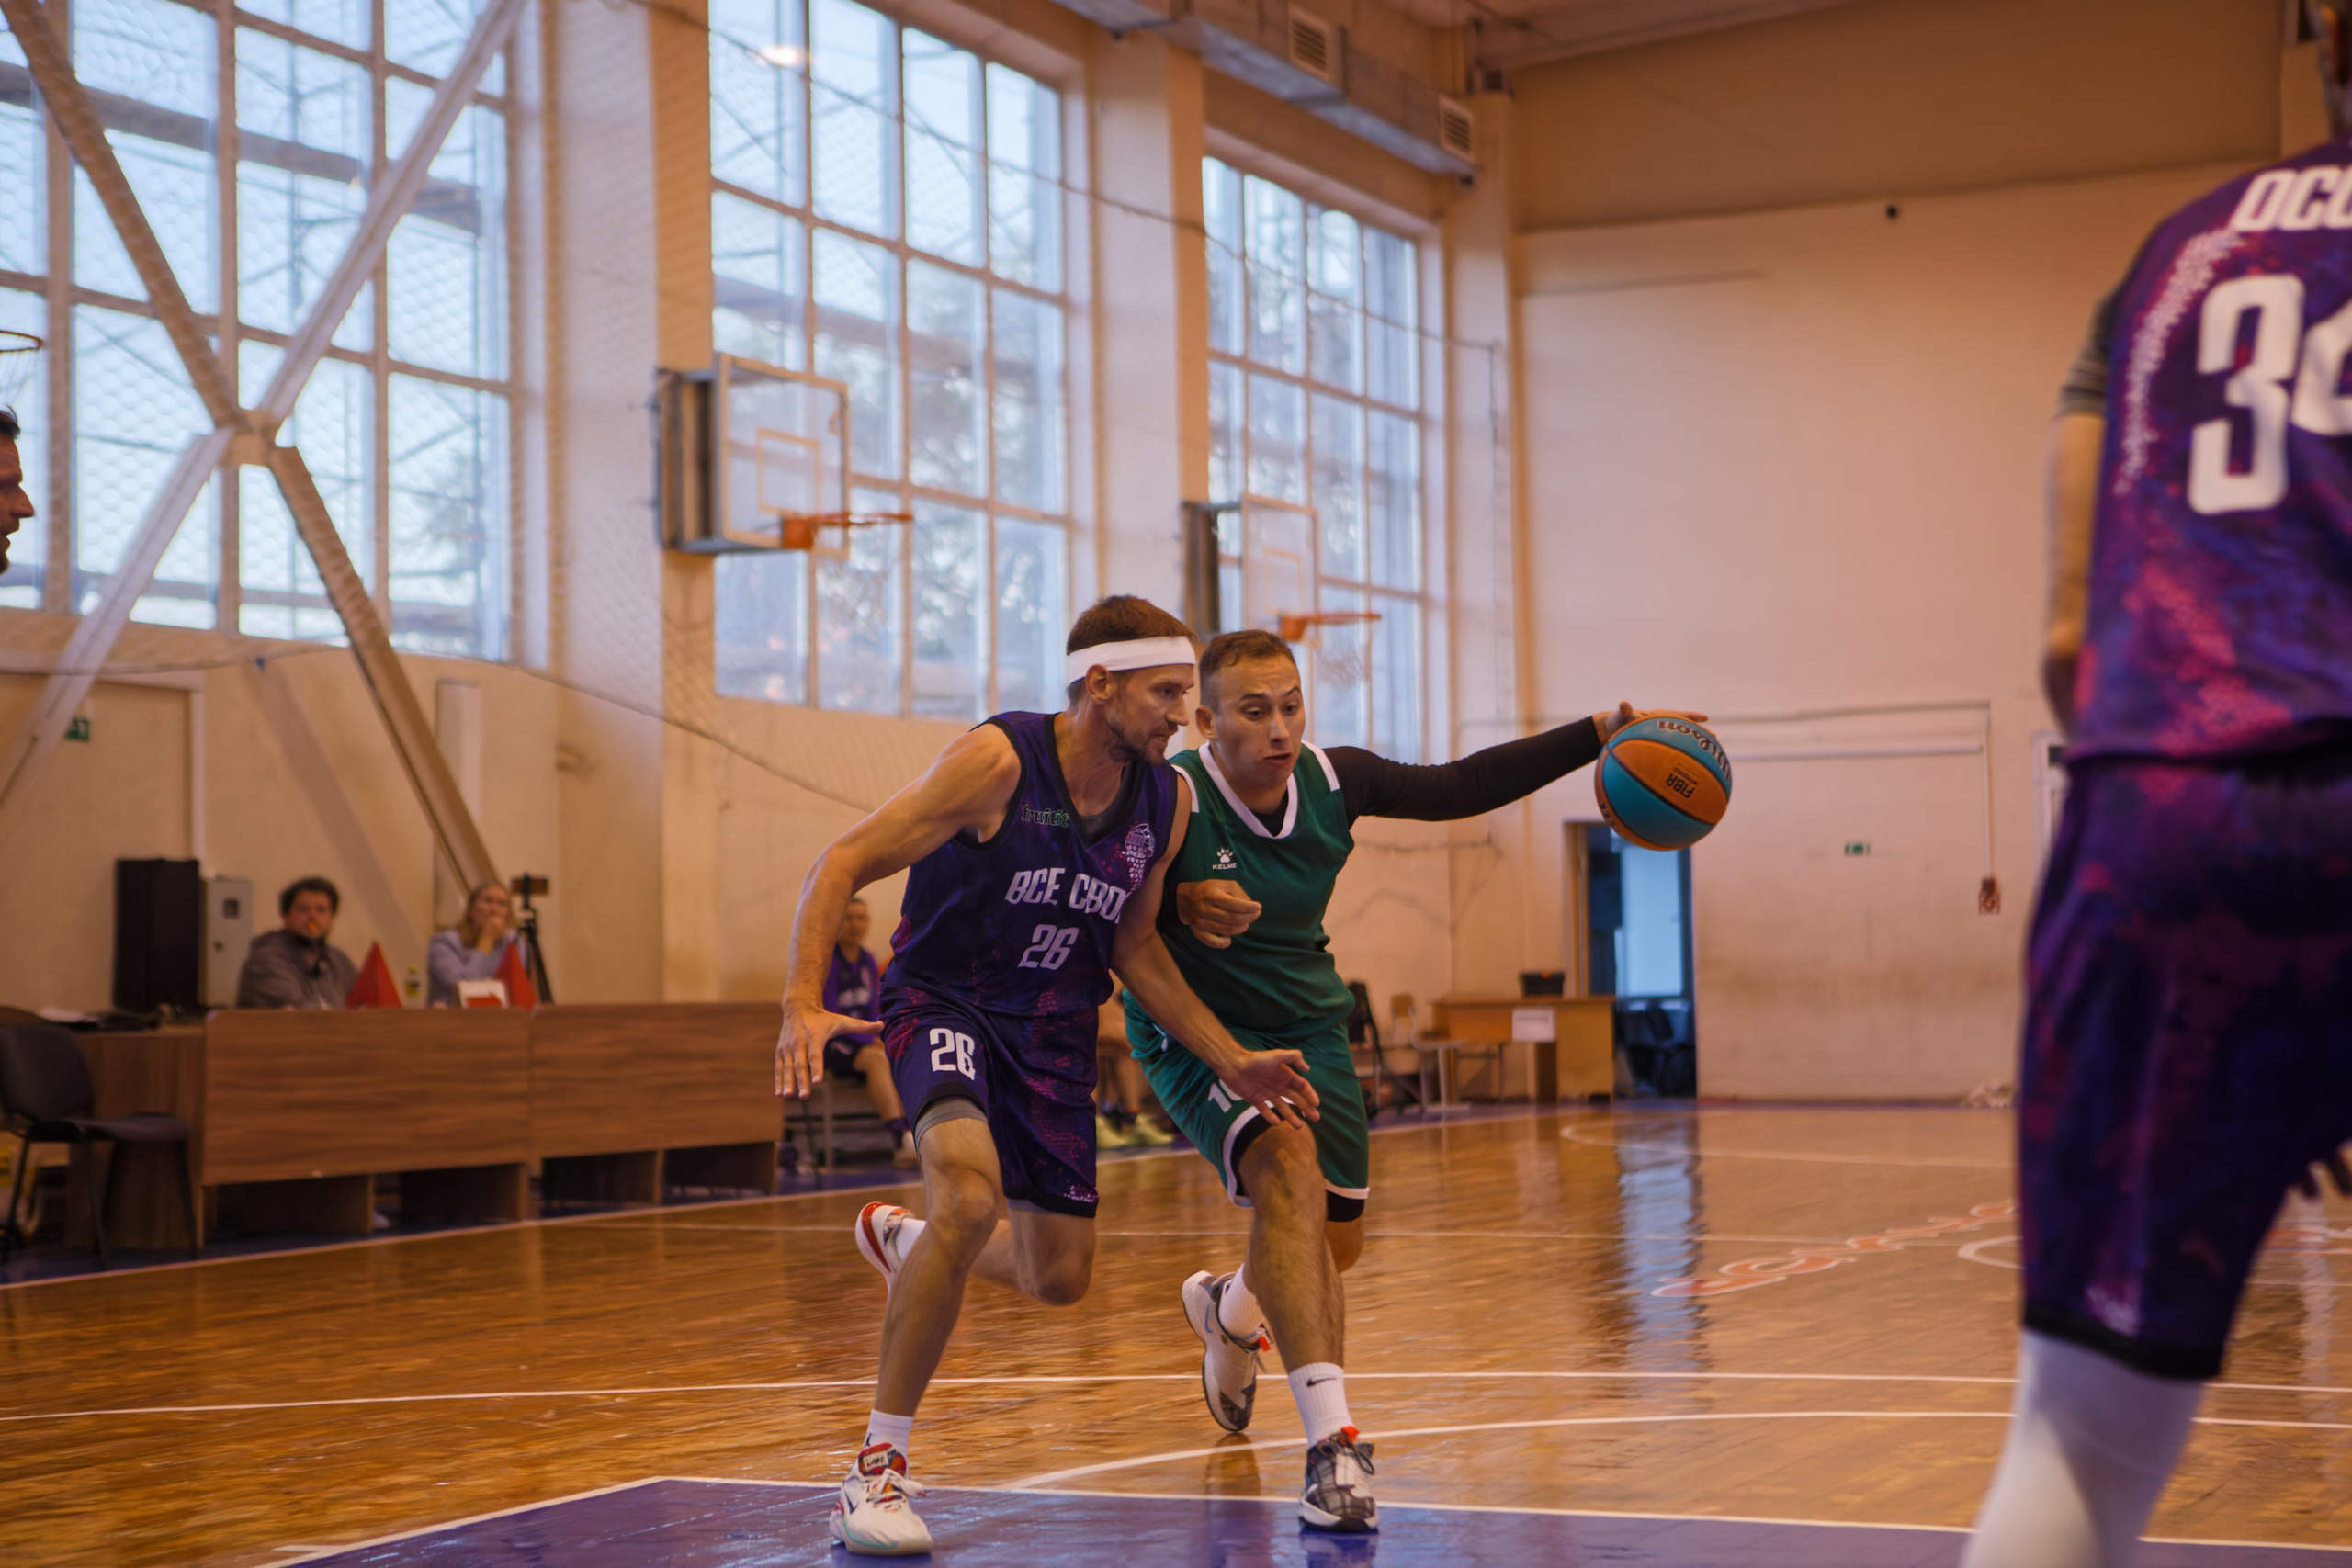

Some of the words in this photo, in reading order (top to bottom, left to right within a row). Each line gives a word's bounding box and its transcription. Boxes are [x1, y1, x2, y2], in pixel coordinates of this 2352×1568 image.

[1666, 773, 1696, 799] FIBA
[1021, 804, 1069, 828] fruitit
[1004, 867, 1066, 905] ВСЕ
[1068, 874, 1132, 924] СВО
[1017, 923, 1080, 970] 26
[929, 1027, 976, 1081] 26
